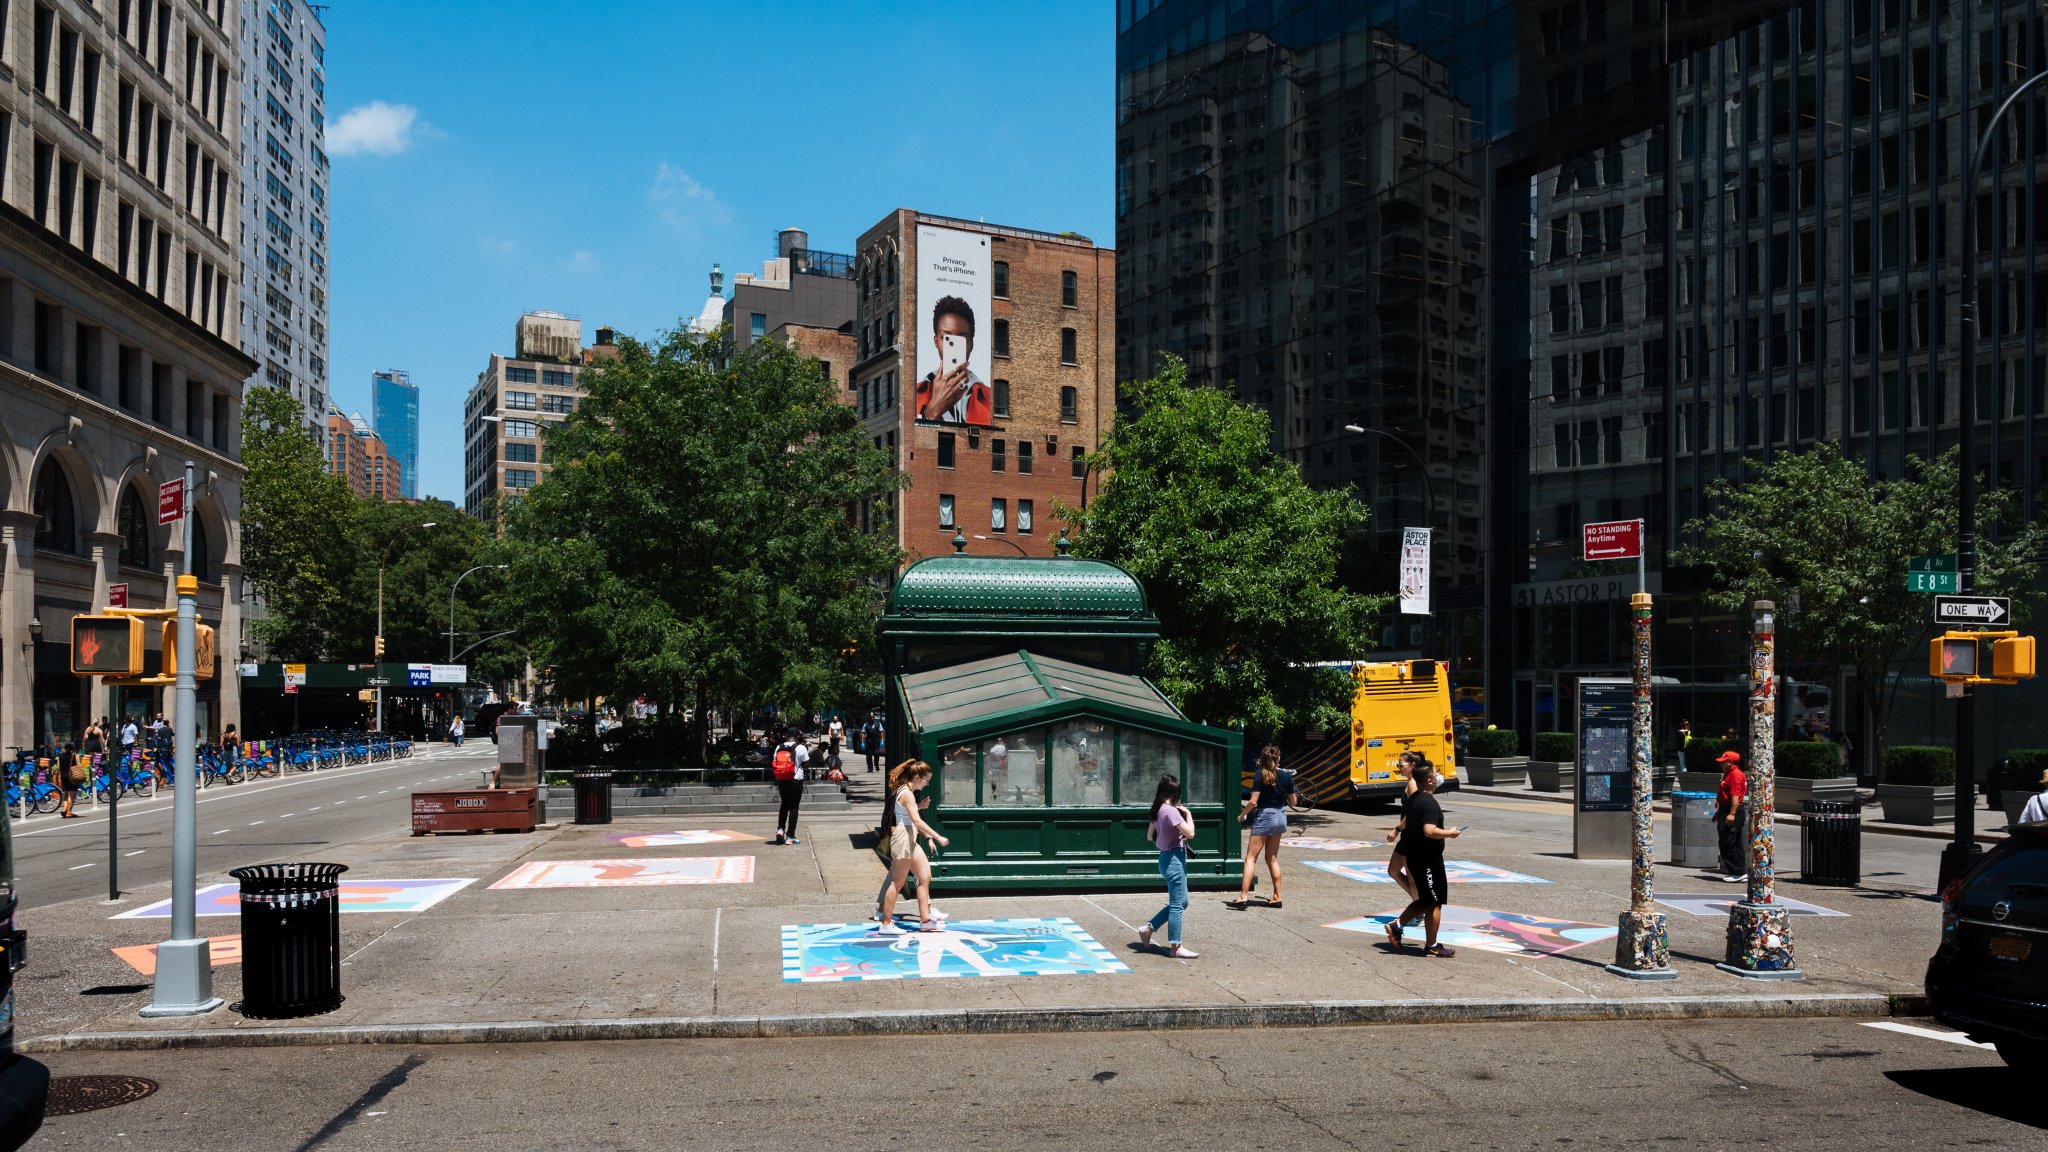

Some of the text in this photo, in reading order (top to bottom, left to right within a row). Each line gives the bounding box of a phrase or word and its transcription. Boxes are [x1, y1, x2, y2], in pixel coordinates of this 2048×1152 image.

[942, 257, 967, 267] Privacy.
[933, 264, 977, 276] That's iPhone.
[166, 483, 181, 495] STANDING
[161, 496, 174, 506] Anytime
[1598, 524, 1632, 534] STANDING
[1405, 538, 1427, 546] PLACE
[1587, 535, 1616, 543] Anytime
[1924, 558, 1944, 572] 4 Av
[1918, 574, 1948, 590] E 8 St
[1518, 588, 1537, 603] 51
[1543, 583, 1600, 602] ASTOR
[1946, 605, 1998, 616] ONE WAY
[457, 799, 485, 807] JOBOX
